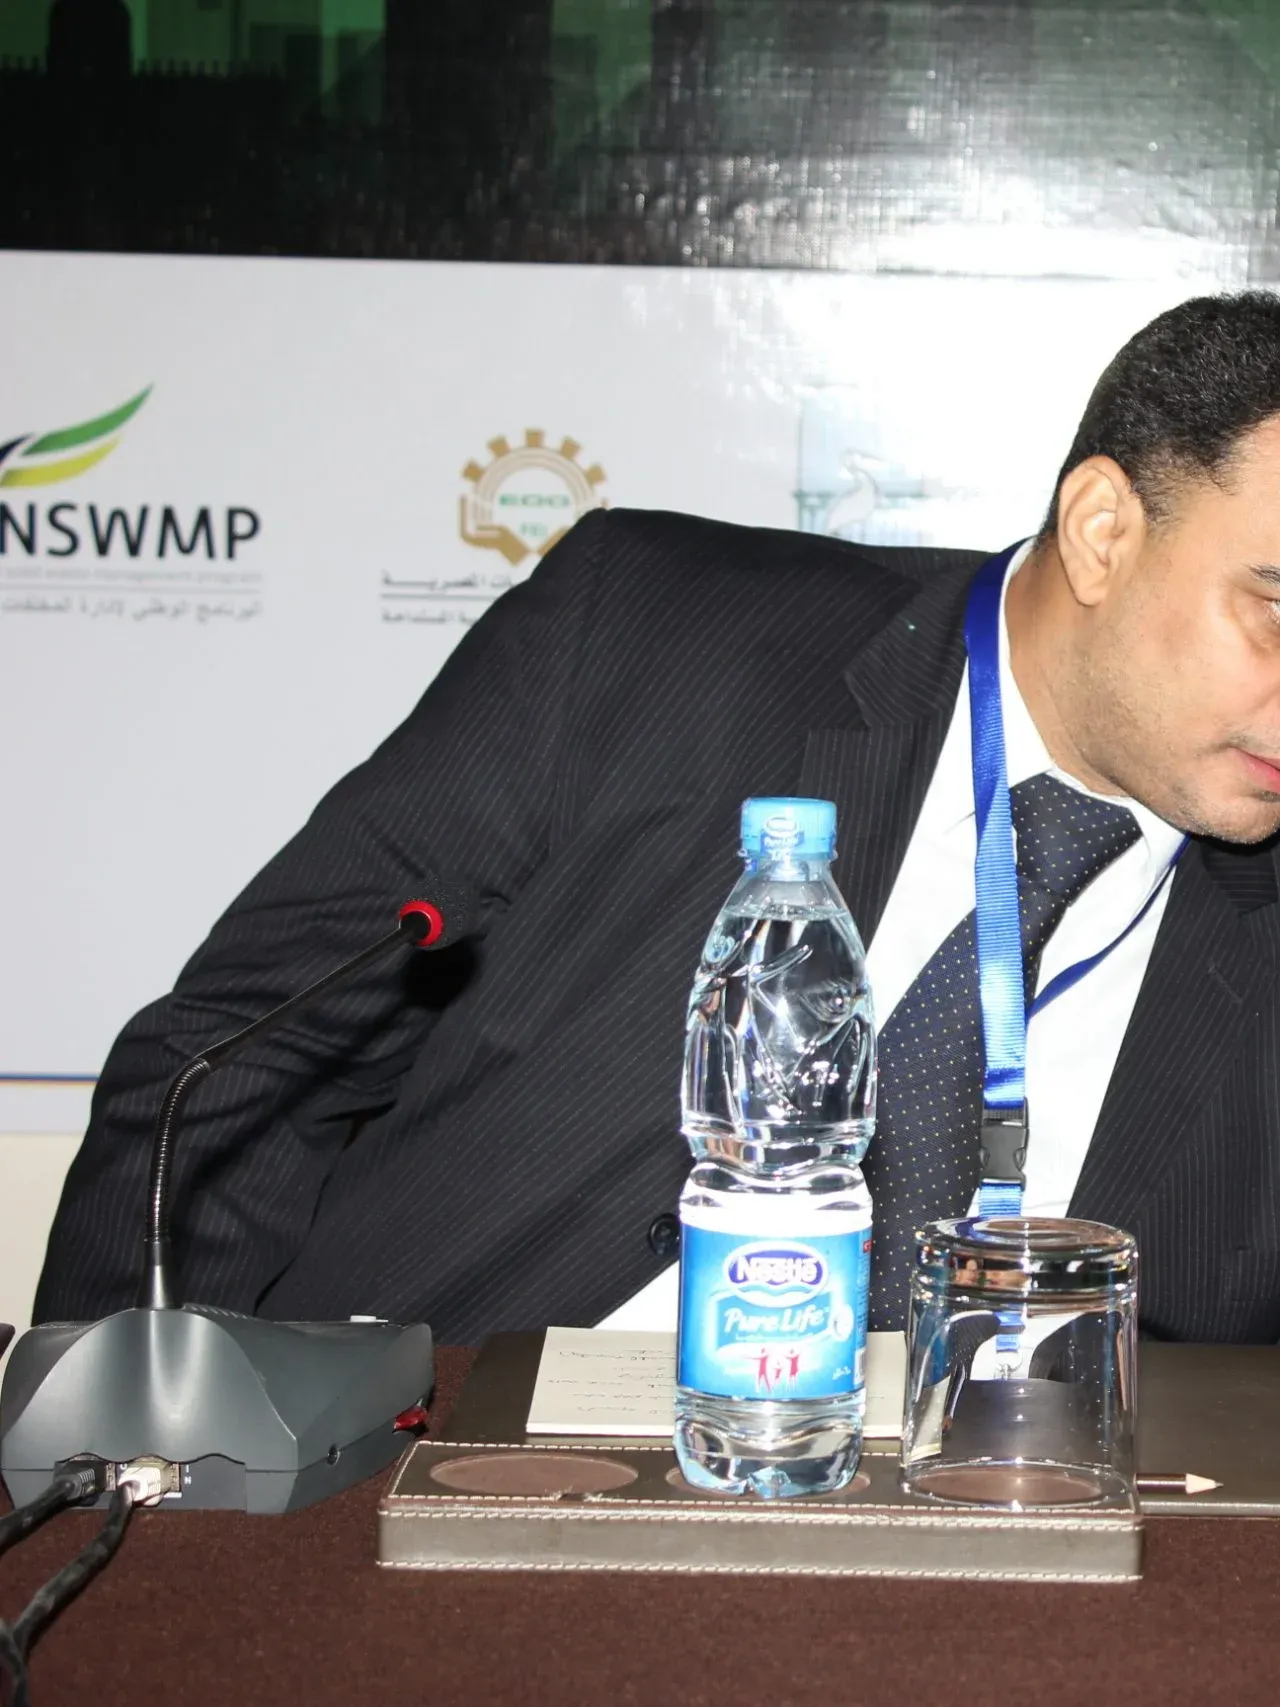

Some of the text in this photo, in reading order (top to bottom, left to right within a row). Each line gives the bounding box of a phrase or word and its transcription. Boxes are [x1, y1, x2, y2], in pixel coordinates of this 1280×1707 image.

[0, 501, 260, 560] NSWMP
[724, 1304, 826, 1334] Pure Life
